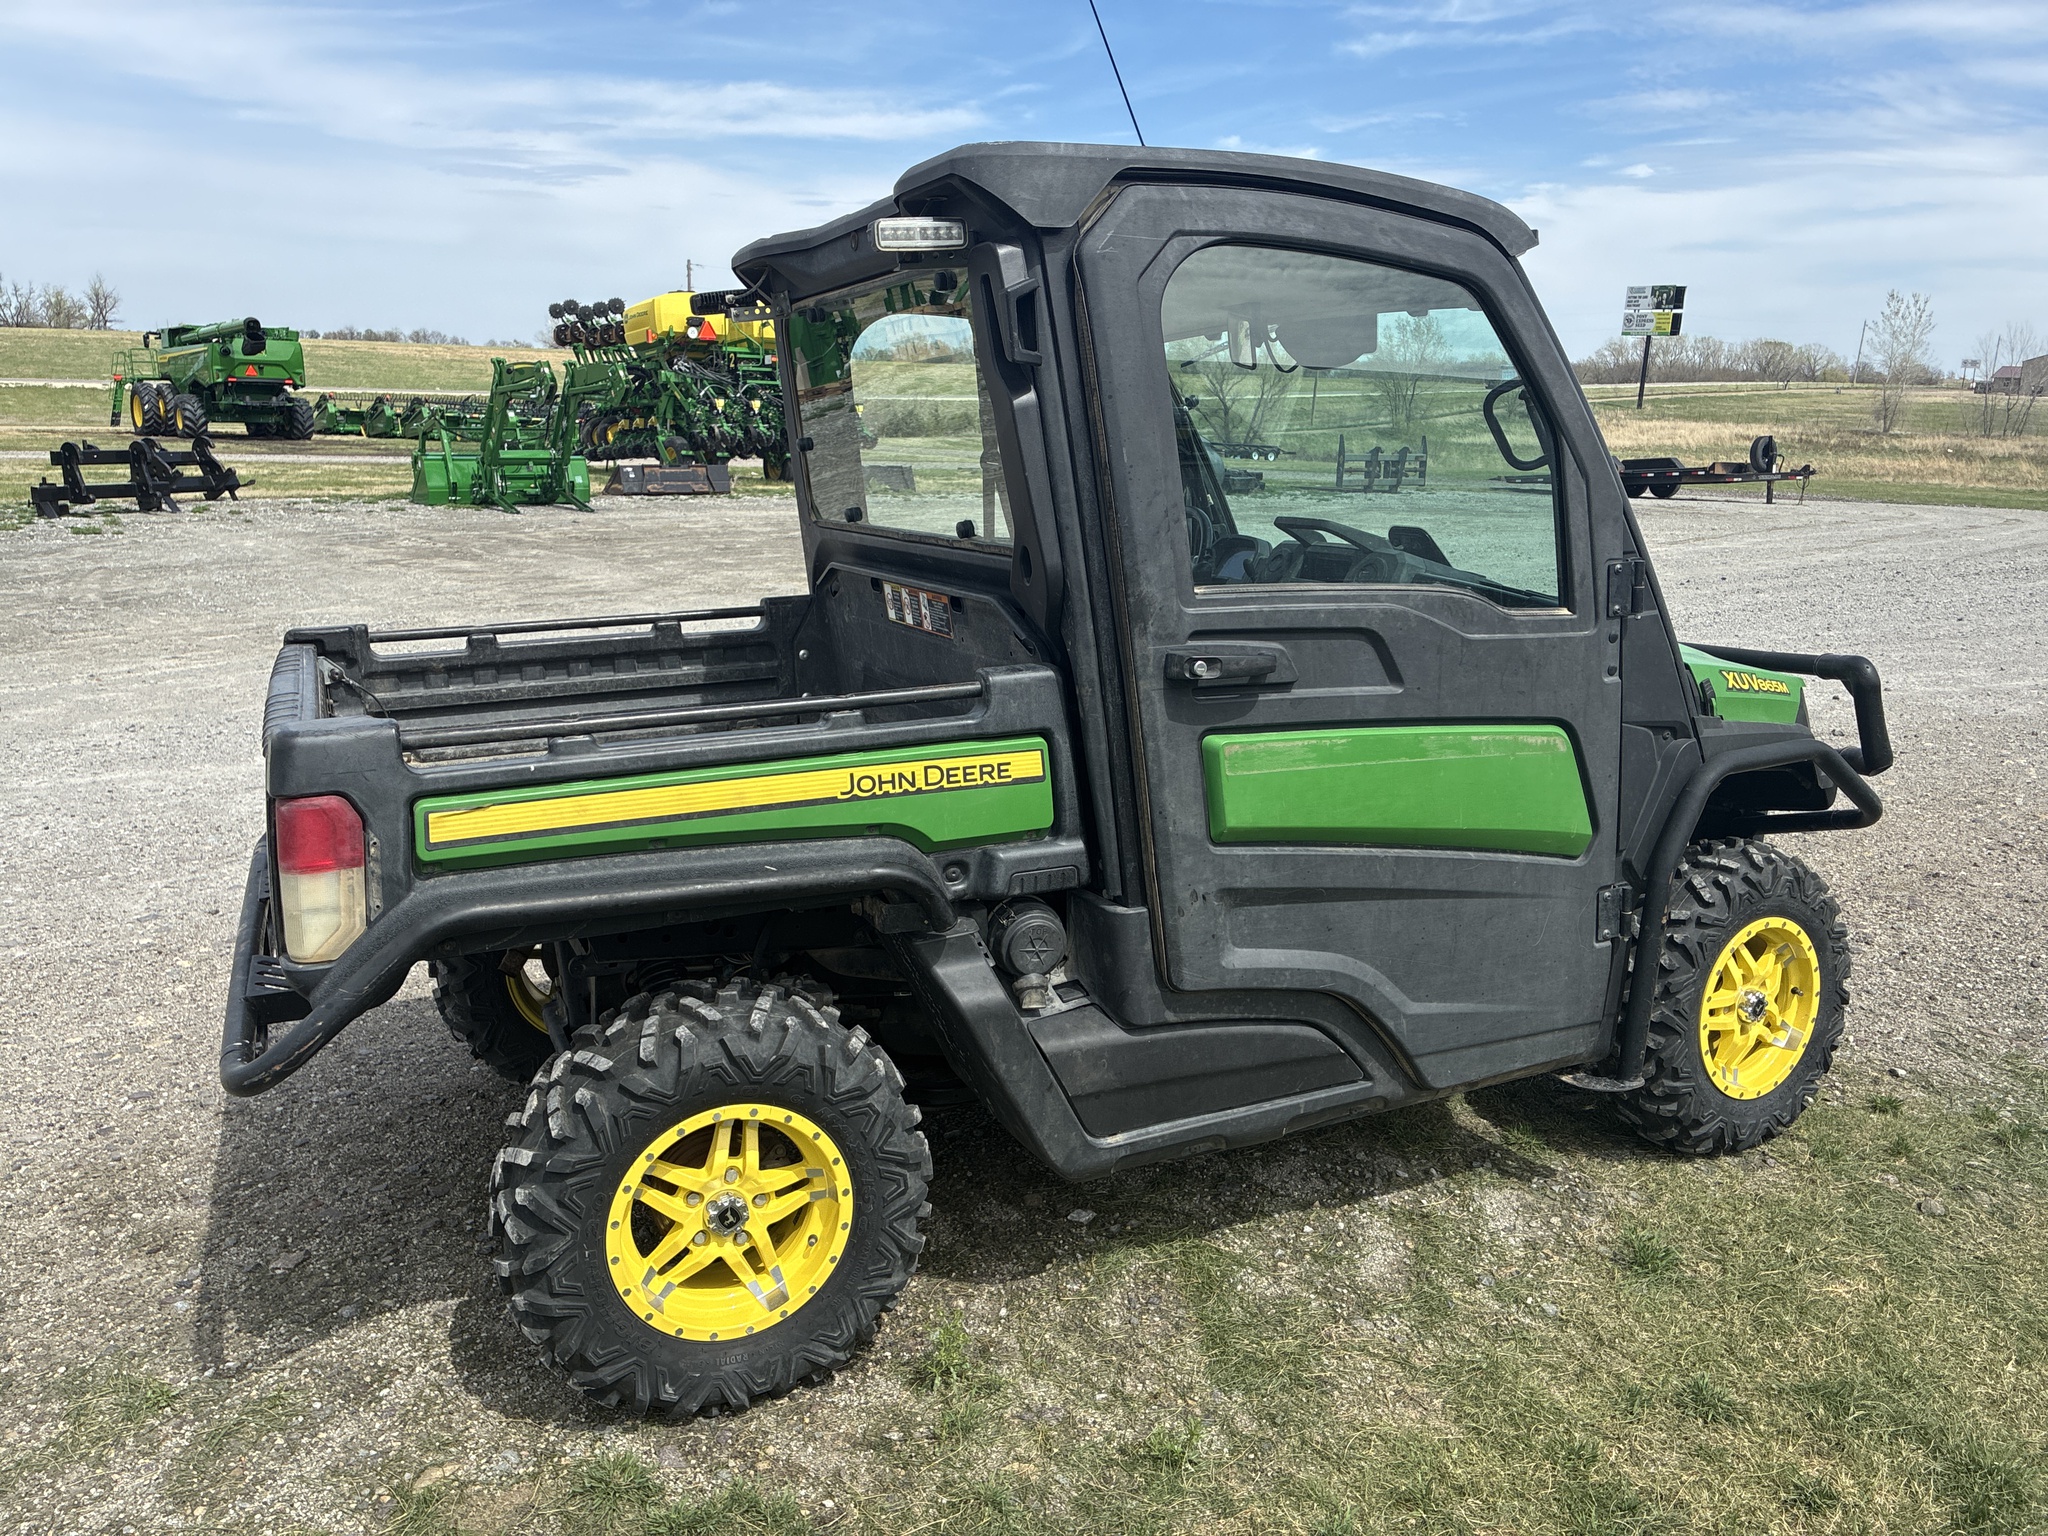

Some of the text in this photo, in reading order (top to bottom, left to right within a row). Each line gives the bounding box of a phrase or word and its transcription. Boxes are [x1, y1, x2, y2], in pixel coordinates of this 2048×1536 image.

[729, 353, 735, 368] 2
[1720, 670, 1789, 694] XUV865M
[840, 762, 1012, 796] JOHN DEERE
[715, 1351, 749, 1366] RADIAL
